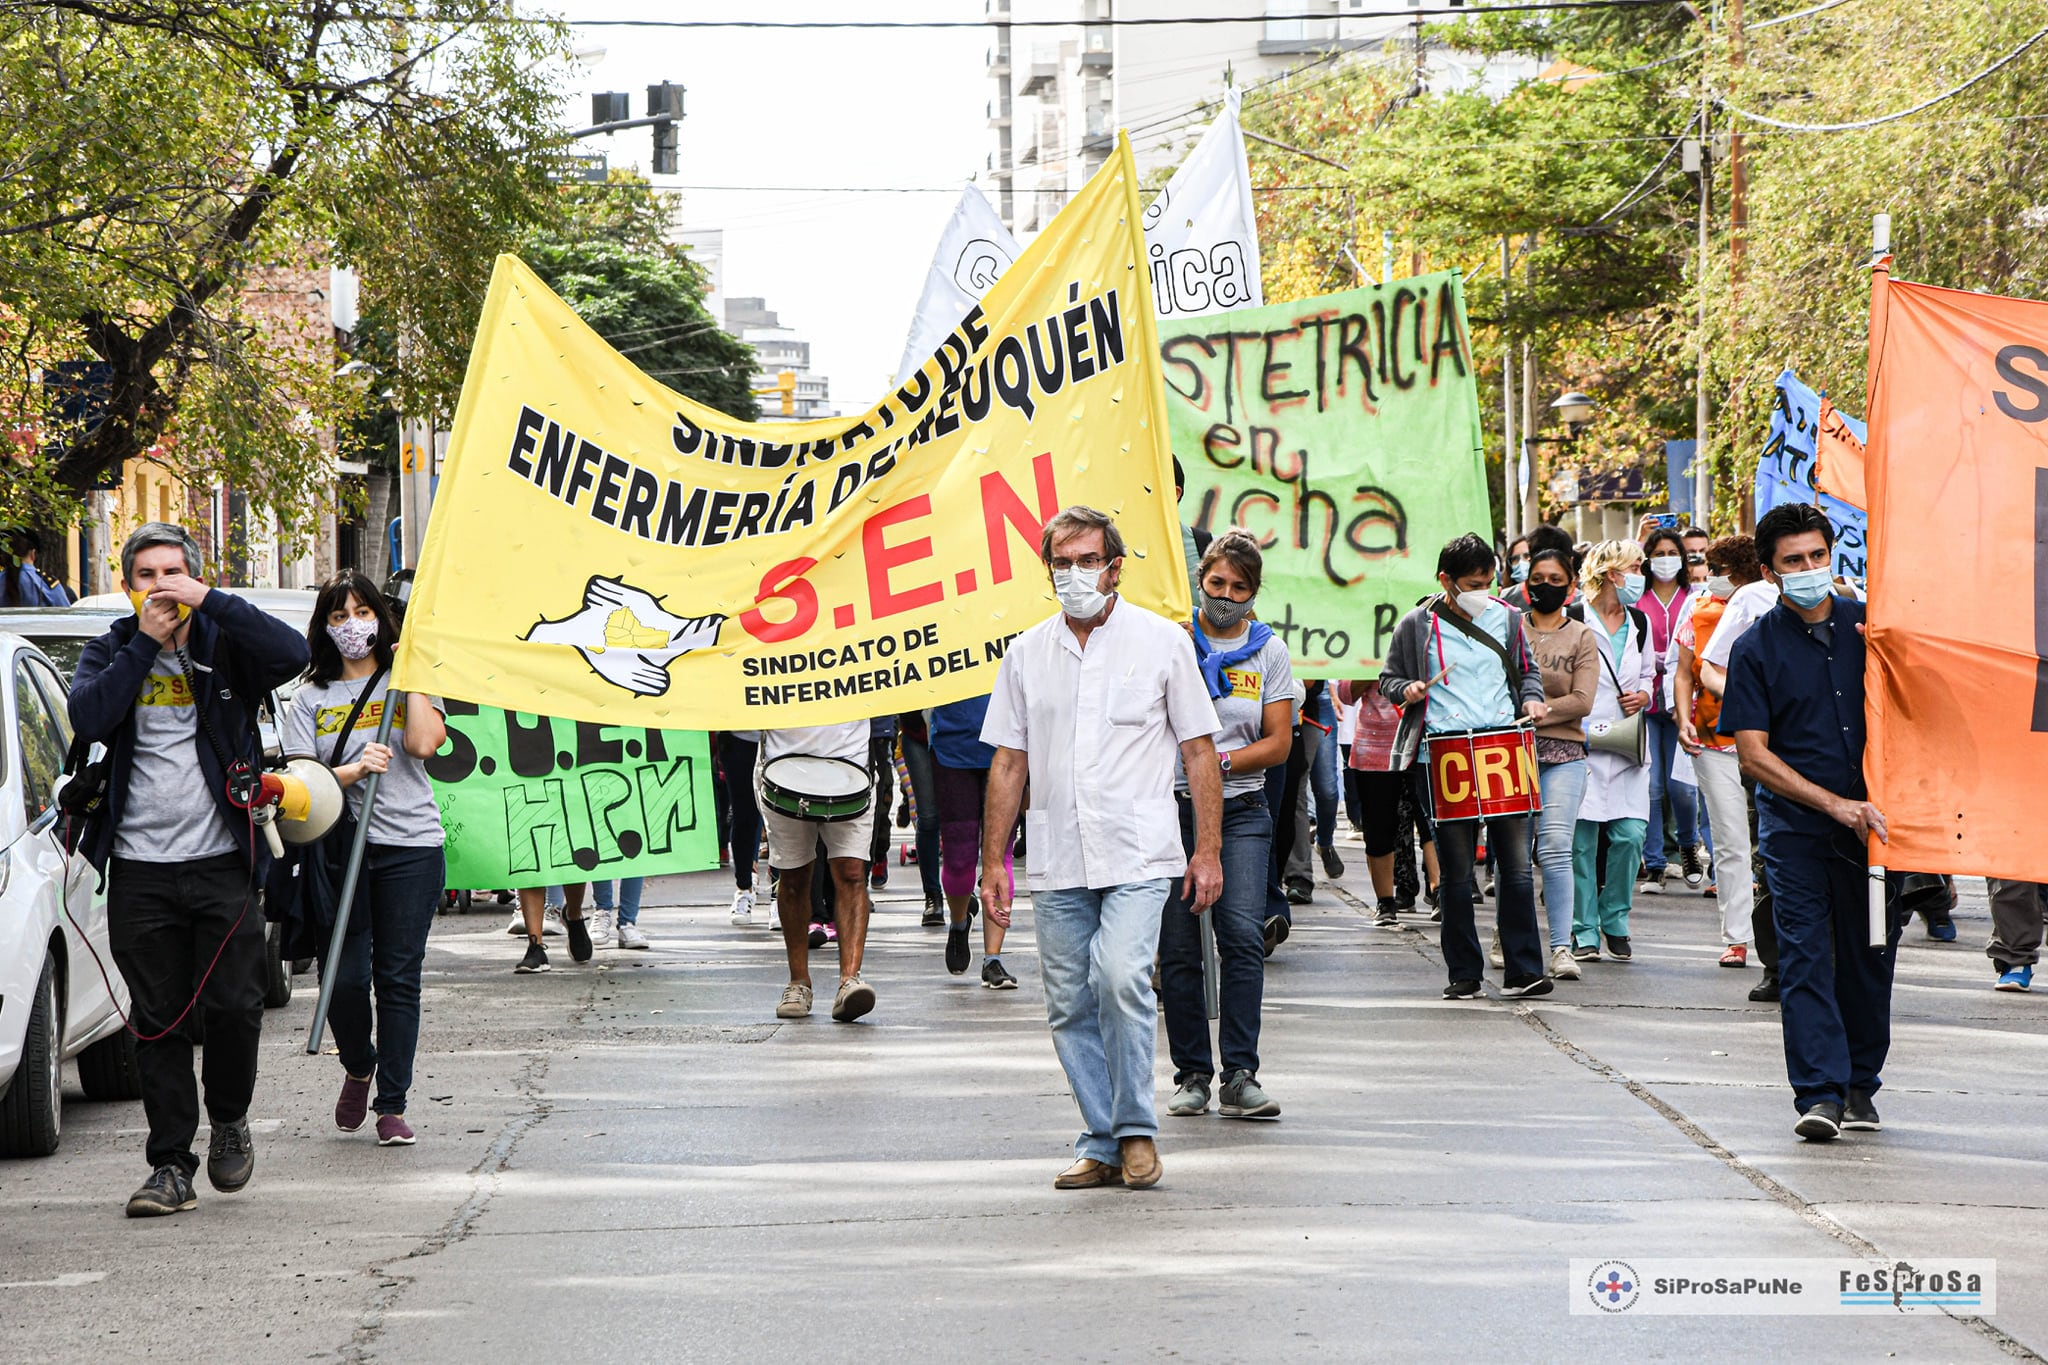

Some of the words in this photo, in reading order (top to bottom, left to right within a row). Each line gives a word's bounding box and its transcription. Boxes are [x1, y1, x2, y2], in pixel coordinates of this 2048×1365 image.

[1149, 240, 1252, 315] ica
[507, 404, 816, 547] ENFERMERÍA
[742, 635, 897, 678] SINDICATO
[903, 623, 940, 648] DE
[1266, 602, 1351, 659] tro
[744, 659, 922, 706] ENFERMERÍA
[928, 647, 980, 679] DEL
[1439, 743, 1541, 803] C.R.N
